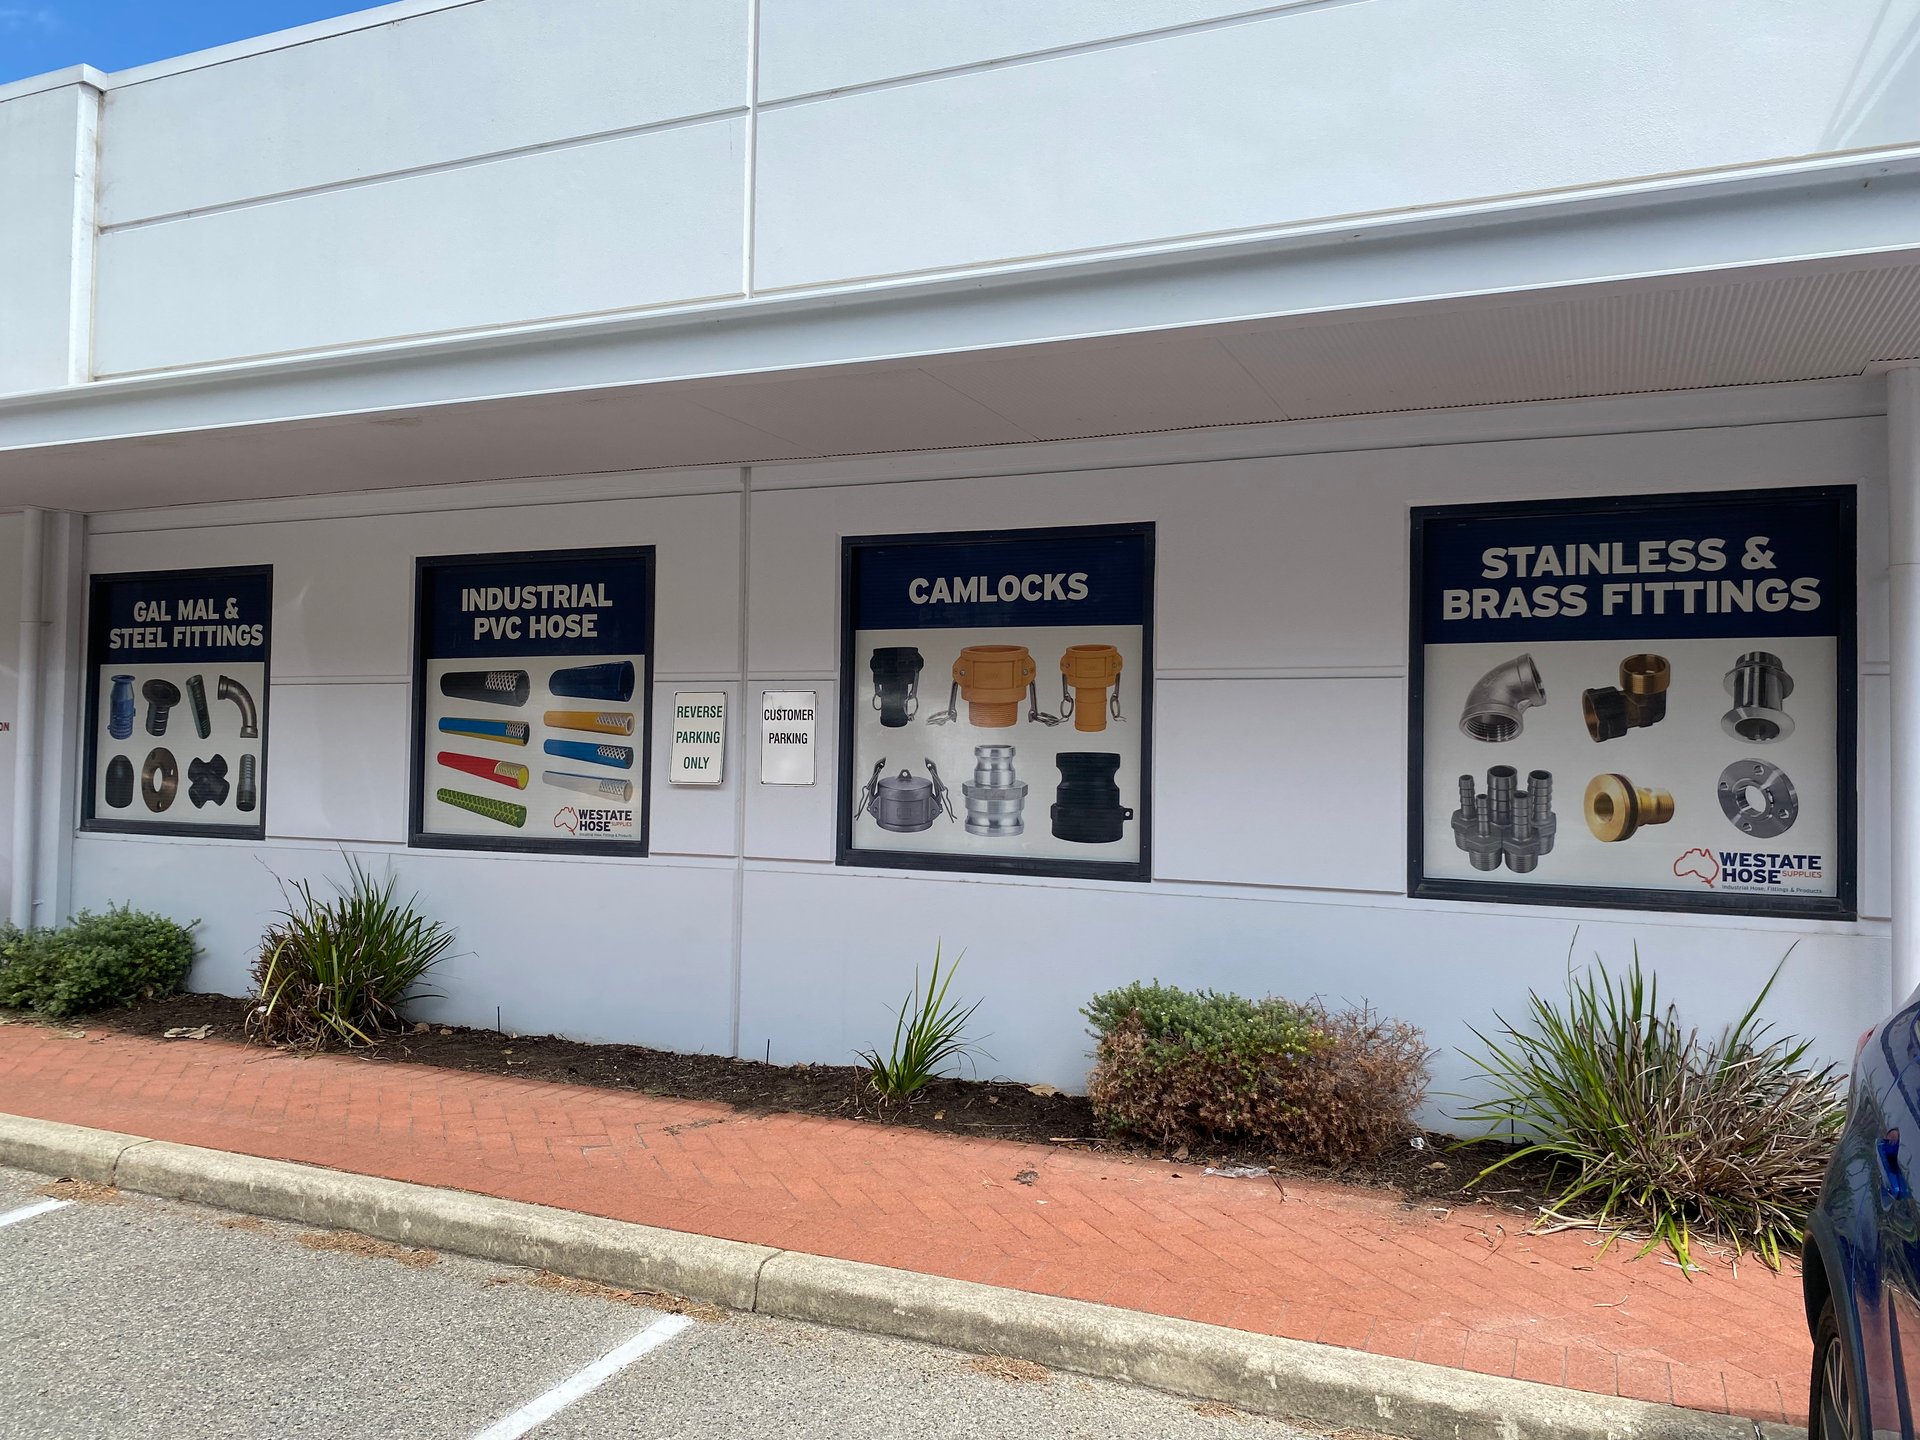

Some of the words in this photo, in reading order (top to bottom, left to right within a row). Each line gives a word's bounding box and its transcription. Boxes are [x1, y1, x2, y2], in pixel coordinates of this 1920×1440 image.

[1481, 538, 1726, 579] STAINLESS
[1740, 536, 1777, 570] &
[908, 572, 1089, 605] CAMLOCKS
[461, 583, 613, 612] INDUSTRIAL
[1443, 585, 1587, 620] BRASS
[1602, 577, 1821, 615] FITTINGS
[133, 601, 171, 622] GAL
[177, 598, 219, 621] MAL
[224, 597, 239, 619] &
[109, 627, 168, 649] STEEL
[173, 623, 264, 648] FITTINGS
[473, 616, 522, 641] PVC
[529, 614, 598, 639] HOSE
[676, 705, 723, 718] REVERSE
[763, 709, 814, 721] CUSTOMER
[676, 731, 721, 744] PARKING
[768, 733, 808, 745] PARKING
[683, 756, 710, 769] ONLY
[578, 809, 633, 821] WESTATE
[579, 820, 611, 832] HOSE
[1719, 852, 1822, 870] WESTATE
[1722, 868, 1781, 884] HOSE
[1782, 870, 1822, 879] SUPPLIES
